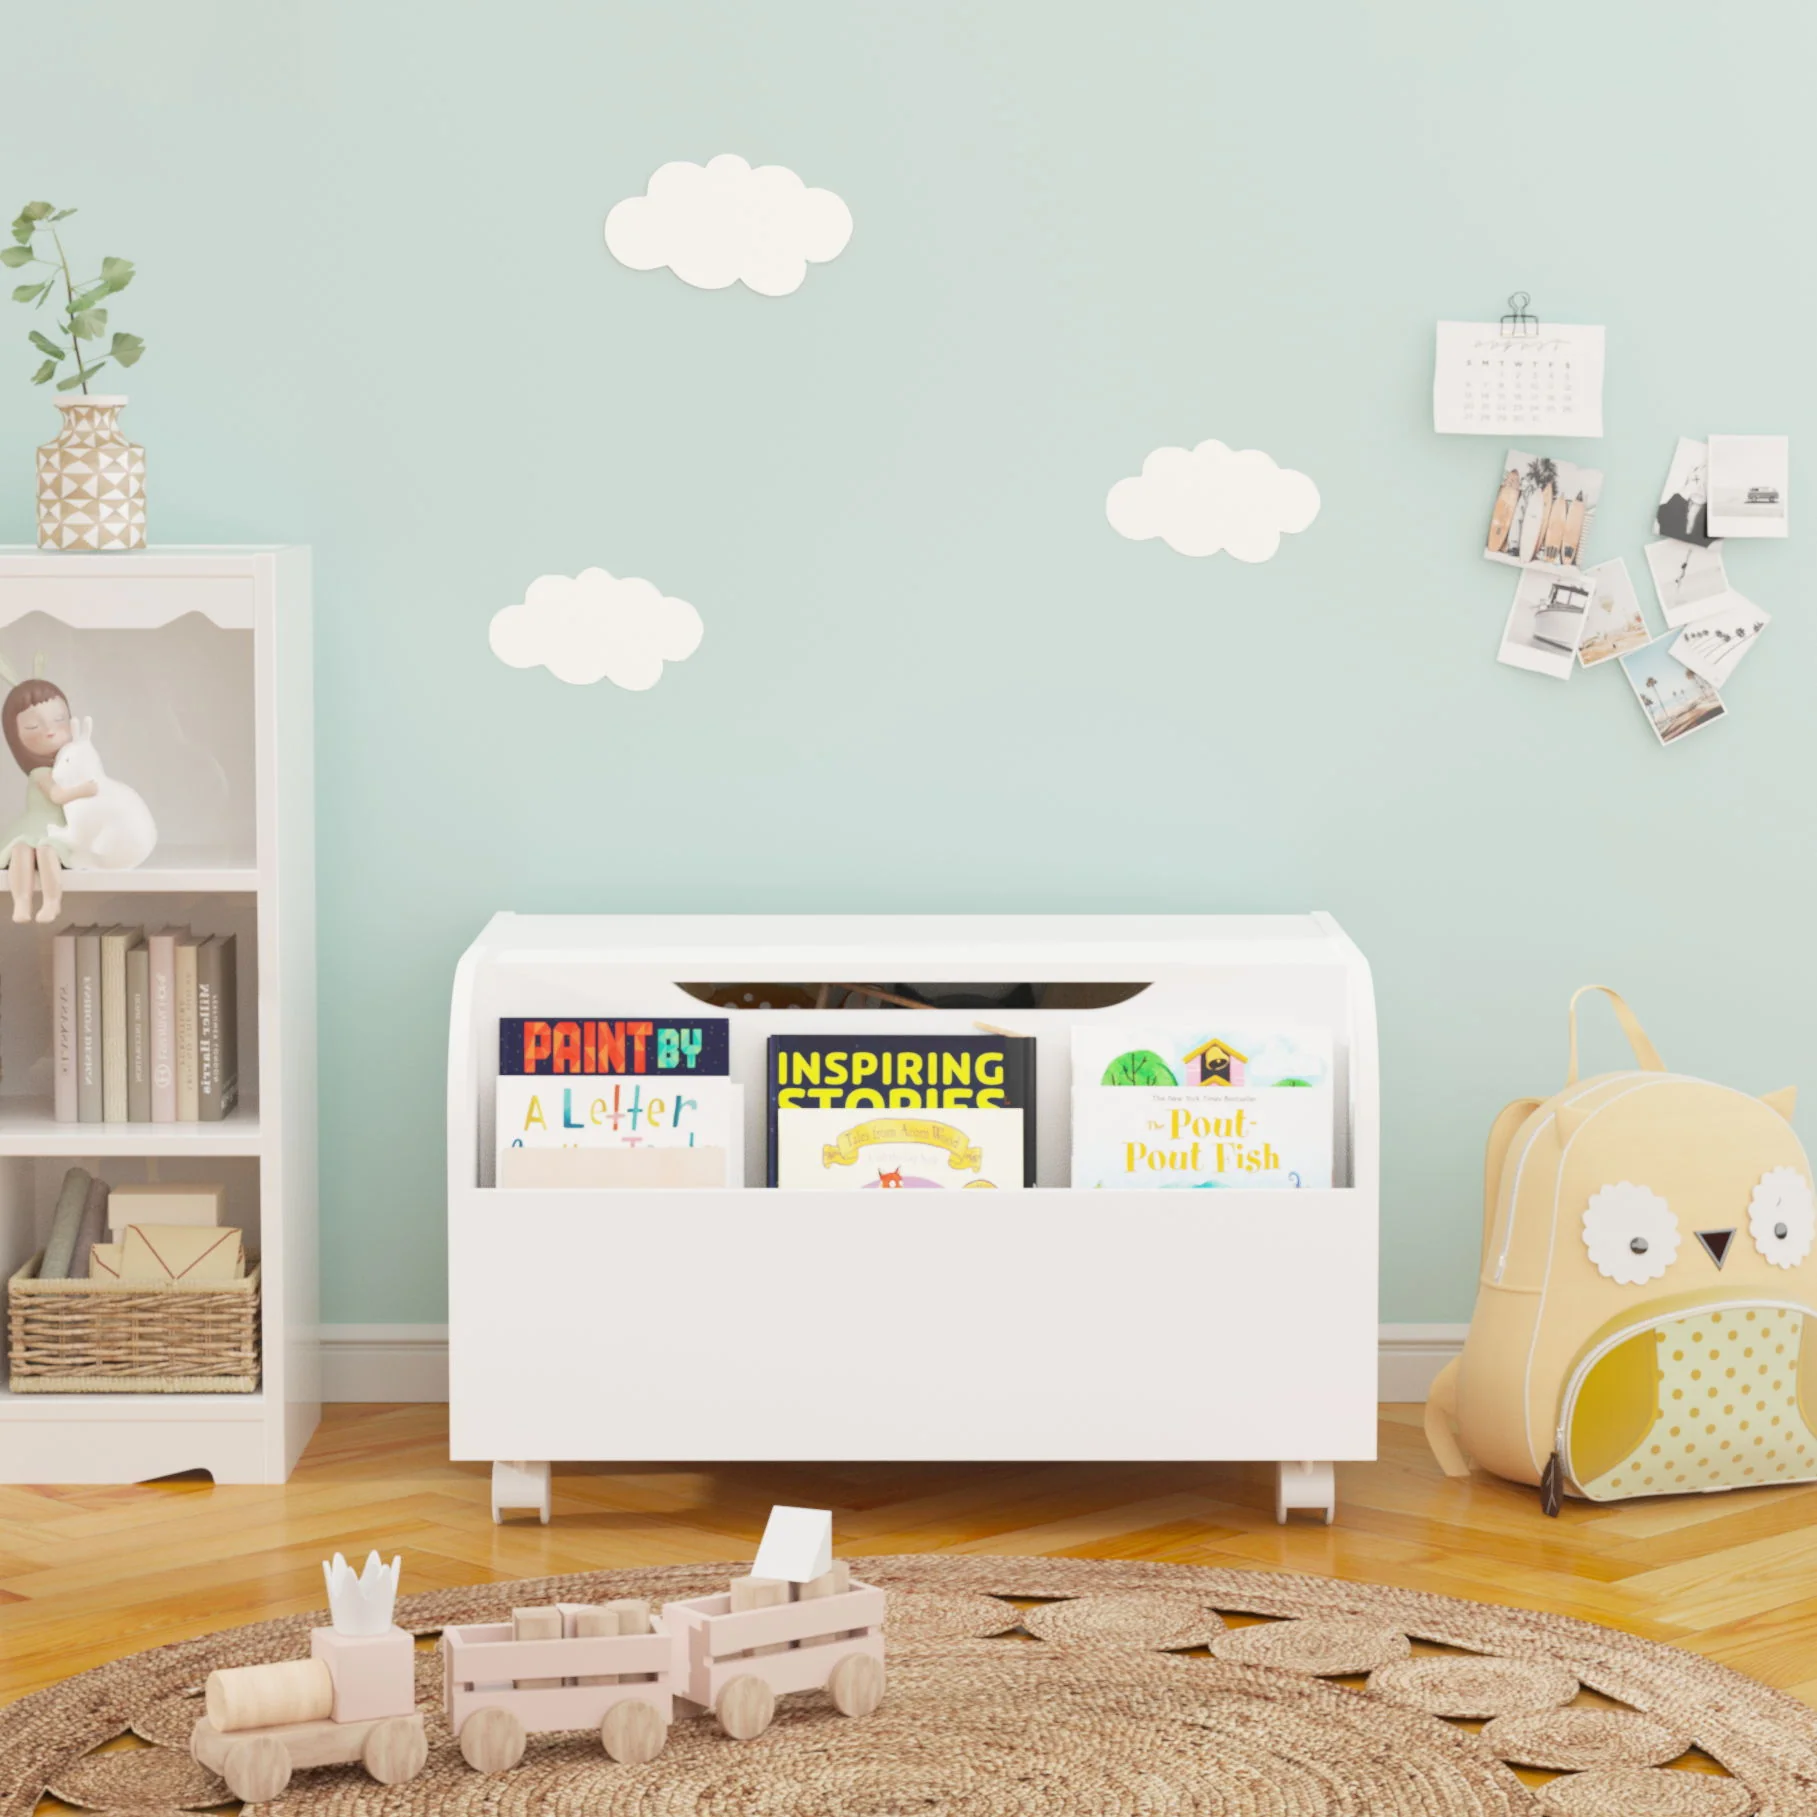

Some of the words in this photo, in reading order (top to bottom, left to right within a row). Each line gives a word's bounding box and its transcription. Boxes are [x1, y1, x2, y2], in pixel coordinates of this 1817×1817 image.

[523, 1021, 653, 1073] PAINT
[657, 1028, 702, 1068] BY
[777, 1051, 1004, 1085] INSPIRING
[523, 1094, 547, 1131] A
[562, 1083, 698, 1132] Letter
[1166, 1107, 1258, 1141] Pout-
[1122, 1140, 1203, 1174] Pout
[1212, 1141, 1281, 1174] Fish
